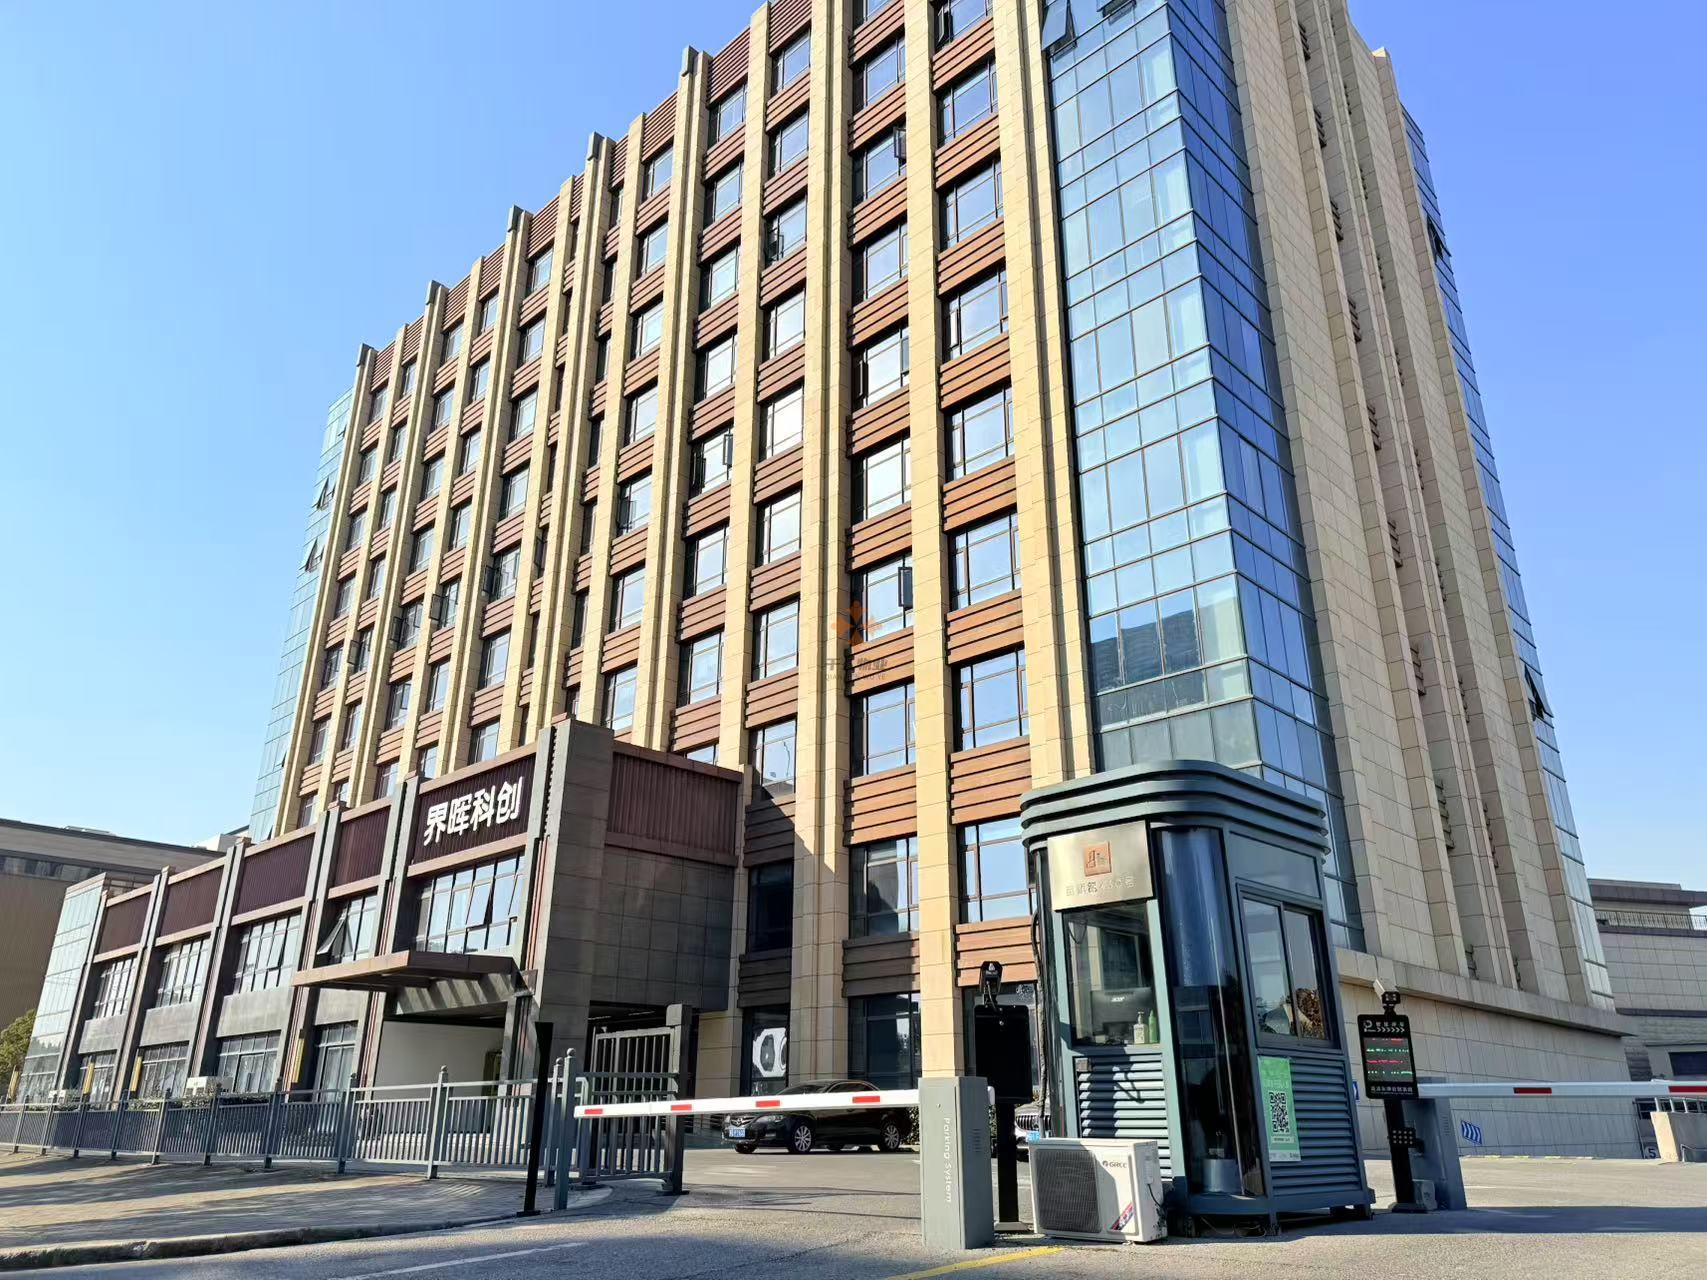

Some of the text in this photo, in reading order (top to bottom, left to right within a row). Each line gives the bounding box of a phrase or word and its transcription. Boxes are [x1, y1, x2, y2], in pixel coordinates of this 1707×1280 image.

[423, 776, 523, 846] 界晖科创
[943, 1117, 952, 1203] Parking System
[1648, 1147, 1657, 1159] 5
